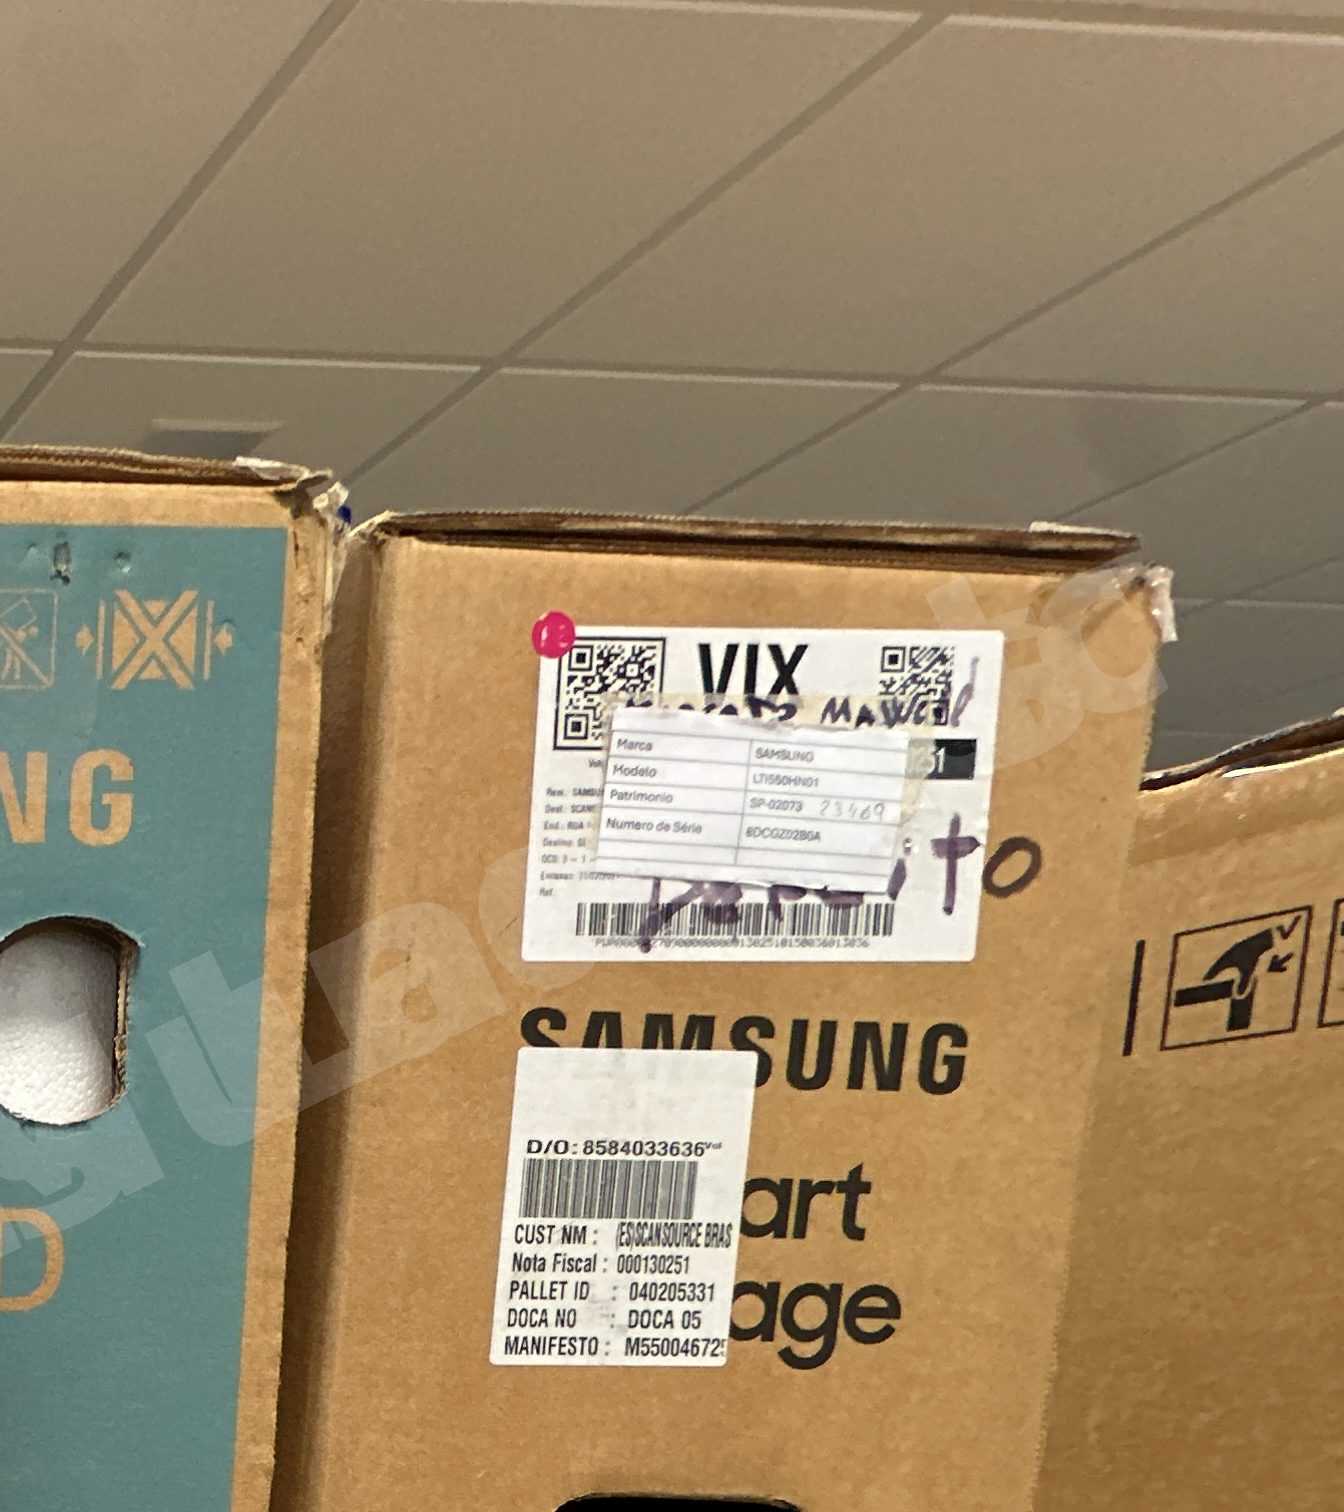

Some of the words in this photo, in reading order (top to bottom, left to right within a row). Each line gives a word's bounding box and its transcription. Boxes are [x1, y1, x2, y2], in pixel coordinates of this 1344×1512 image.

[699, 643, 808, 695] VIX
[617, 739, 653, 751] Marca
[755, 749, 814, 762] SAMSUNG
[613, 765, 657, 778] Modelo
[610, 789, 673, 803] Patrimonio
[607, 818, 653, 831] Numero
[583, 1140, 704, 1156] 8584033636
[515, 1224, 555, 1244] CUST
[562, 1225, 587, 1244] NM
[704, 1223, 732, 1248] BRAS
[512, 1253, 546, 1272] Nota
[552, 1254, 597, 1272] Fiscal
[617, 1255, 690, 1274] 000130251
[509, 1281, 567, 1300] PALLET
[574, 1281, 589, 1300] ID
[630, 1282, 714, 1302] 040205331
[508, 1308, 548, 1327] DOCA
[555, 1309, 576, 1328] NO
[628, 1310, 674, 1329] DOCA
[681, 1310, 701, 1329] 05
[504, 1336, 598, 1355] MANIFESTO
